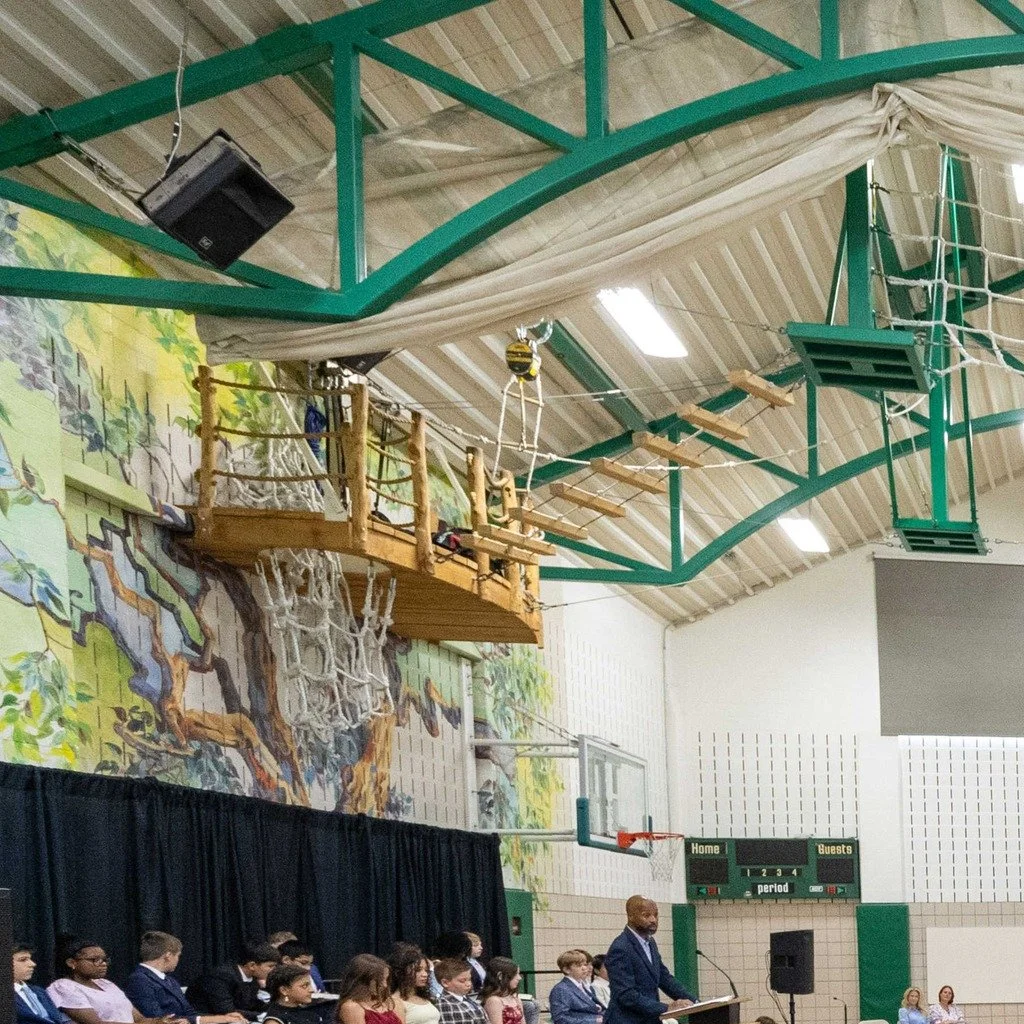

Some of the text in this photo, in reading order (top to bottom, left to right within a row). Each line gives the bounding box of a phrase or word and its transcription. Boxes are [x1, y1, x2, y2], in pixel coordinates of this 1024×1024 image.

[691, 842, 720, 855] Home
[817, 843, 853, 855] Guests
[761, 868, 767, 877] 2
[776, 868, 782, 877] 3
[791, 868, 798, 877] 4
[757, 882, 789, 895] period
